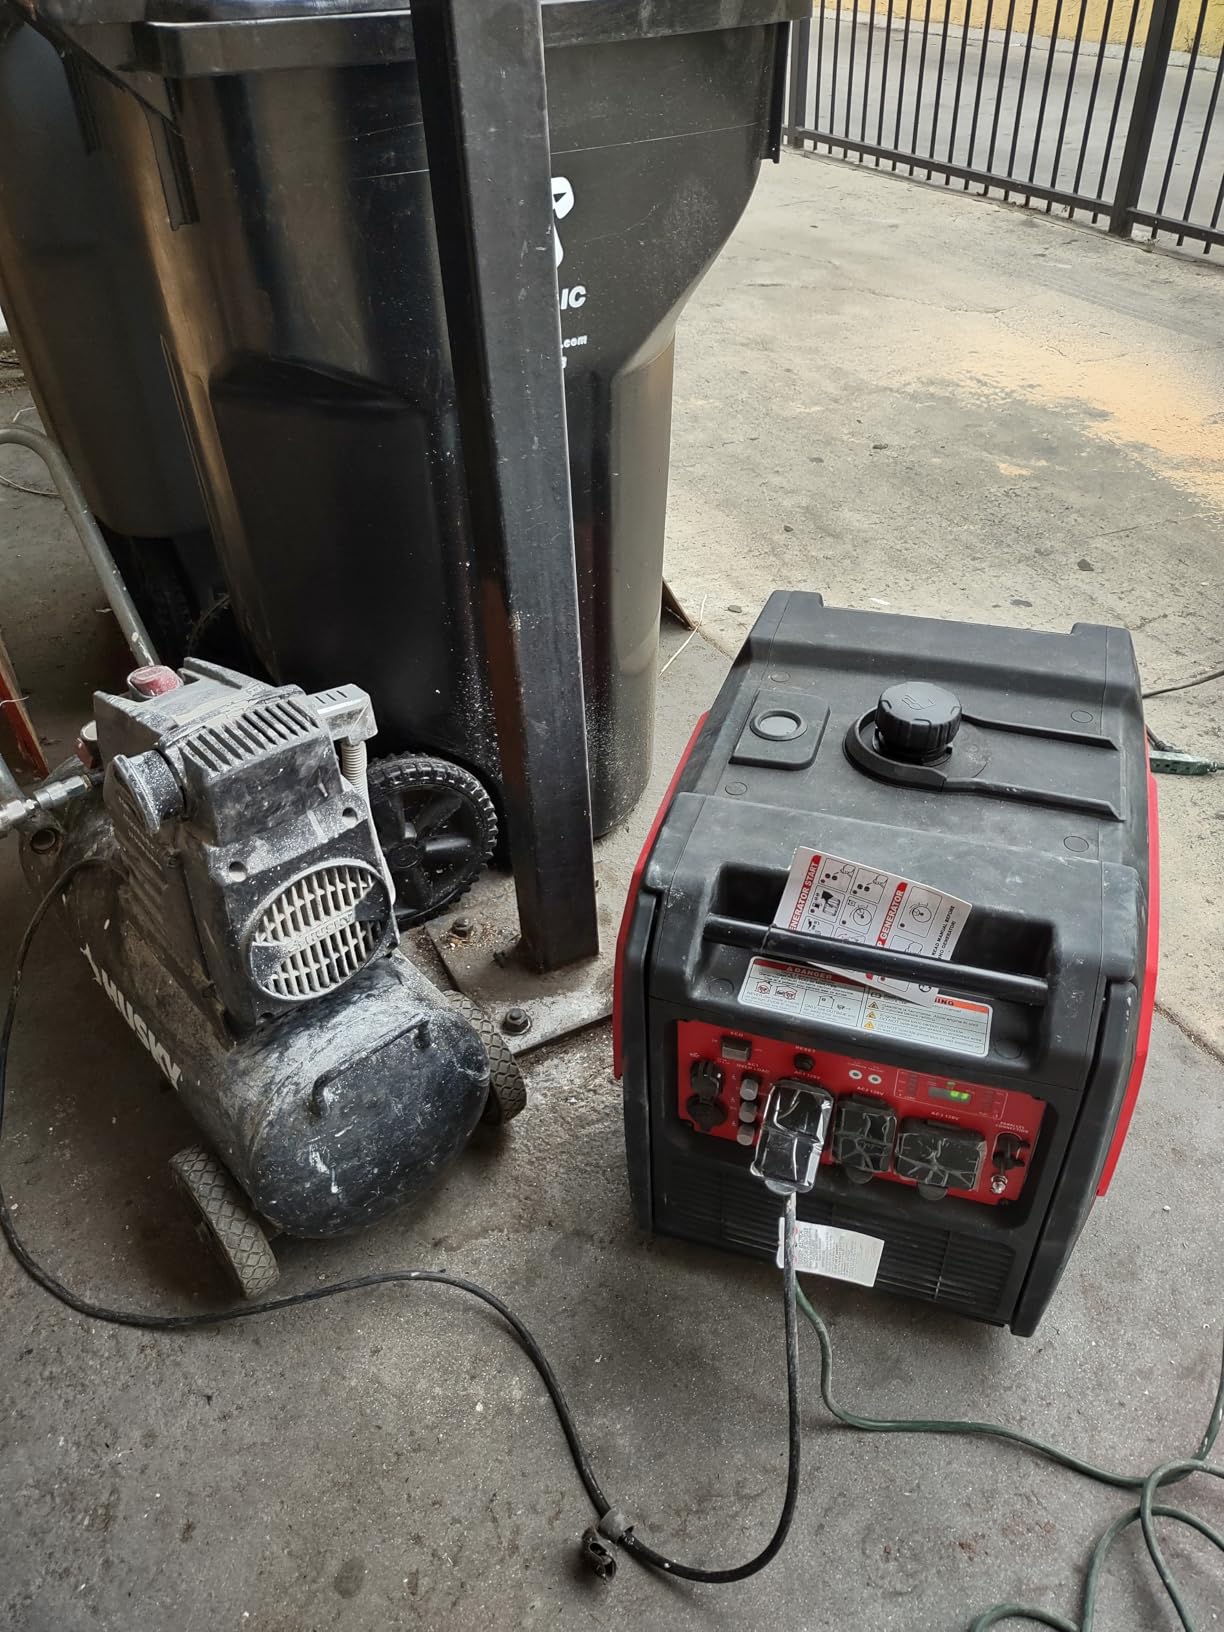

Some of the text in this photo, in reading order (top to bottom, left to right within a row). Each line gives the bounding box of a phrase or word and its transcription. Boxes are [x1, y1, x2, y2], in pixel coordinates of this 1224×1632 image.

[561, 285, 586, 310] IC
[789, 863, 818, 931] ENERATOR START
[880, 890, 904, 940] GENERATOR
[304, 910, 354, 946] HUSKY
[937, 923, 946, 944] MANUAL
[945, 905, 955, 923] BEFORE
[795, 967, 832, 980] DANGER
[934, 997, 954, 1006] ING
[101, 968, 180, 1091] HUSKY
